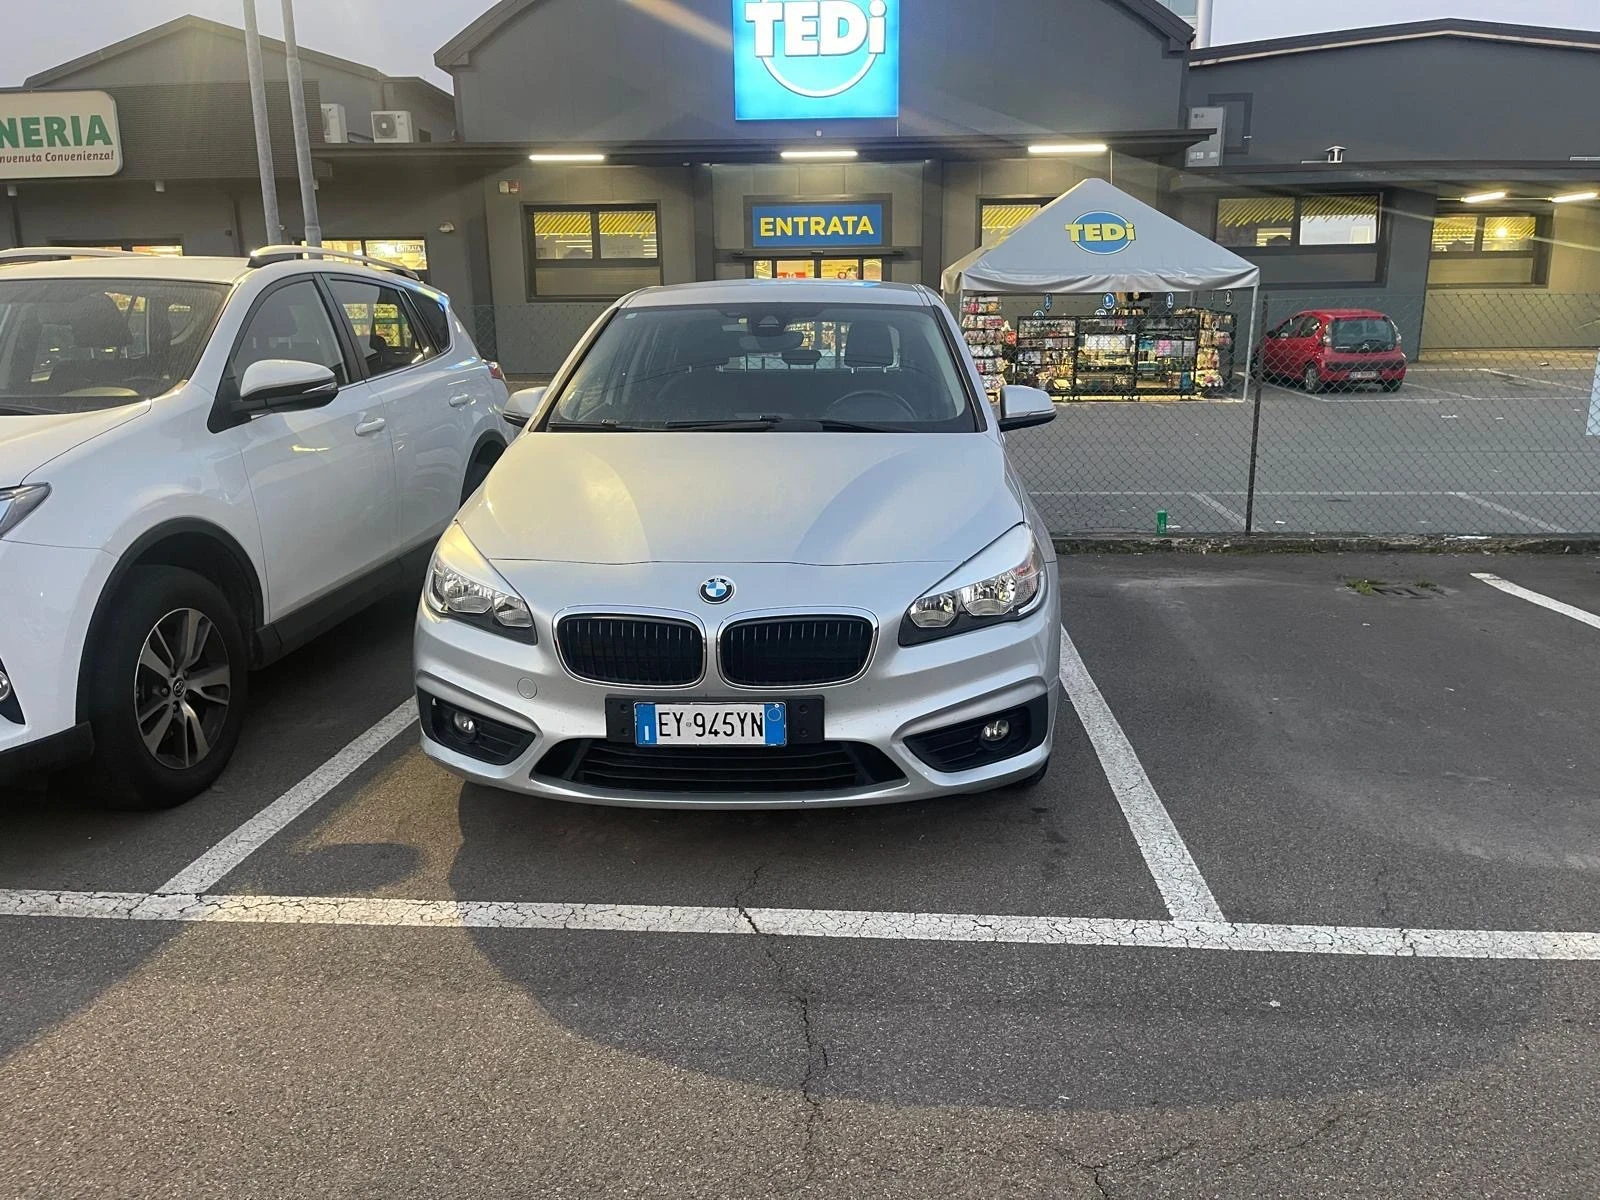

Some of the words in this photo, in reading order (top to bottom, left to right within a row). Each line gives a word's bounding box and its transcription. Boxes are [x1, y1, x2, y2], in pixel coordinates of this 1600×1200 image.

[744, 0, 887, 57] TEDi
[0, 115, 113, 148] NERIA
[45, 150, 114, 162] Convenienza!
[760, 216, 874, 236] ENTRATA
[1065, 223, 1136, 242] TEDi
[658, 712, 683, 737] EY
[693, 711, 763, 737] 945YN
